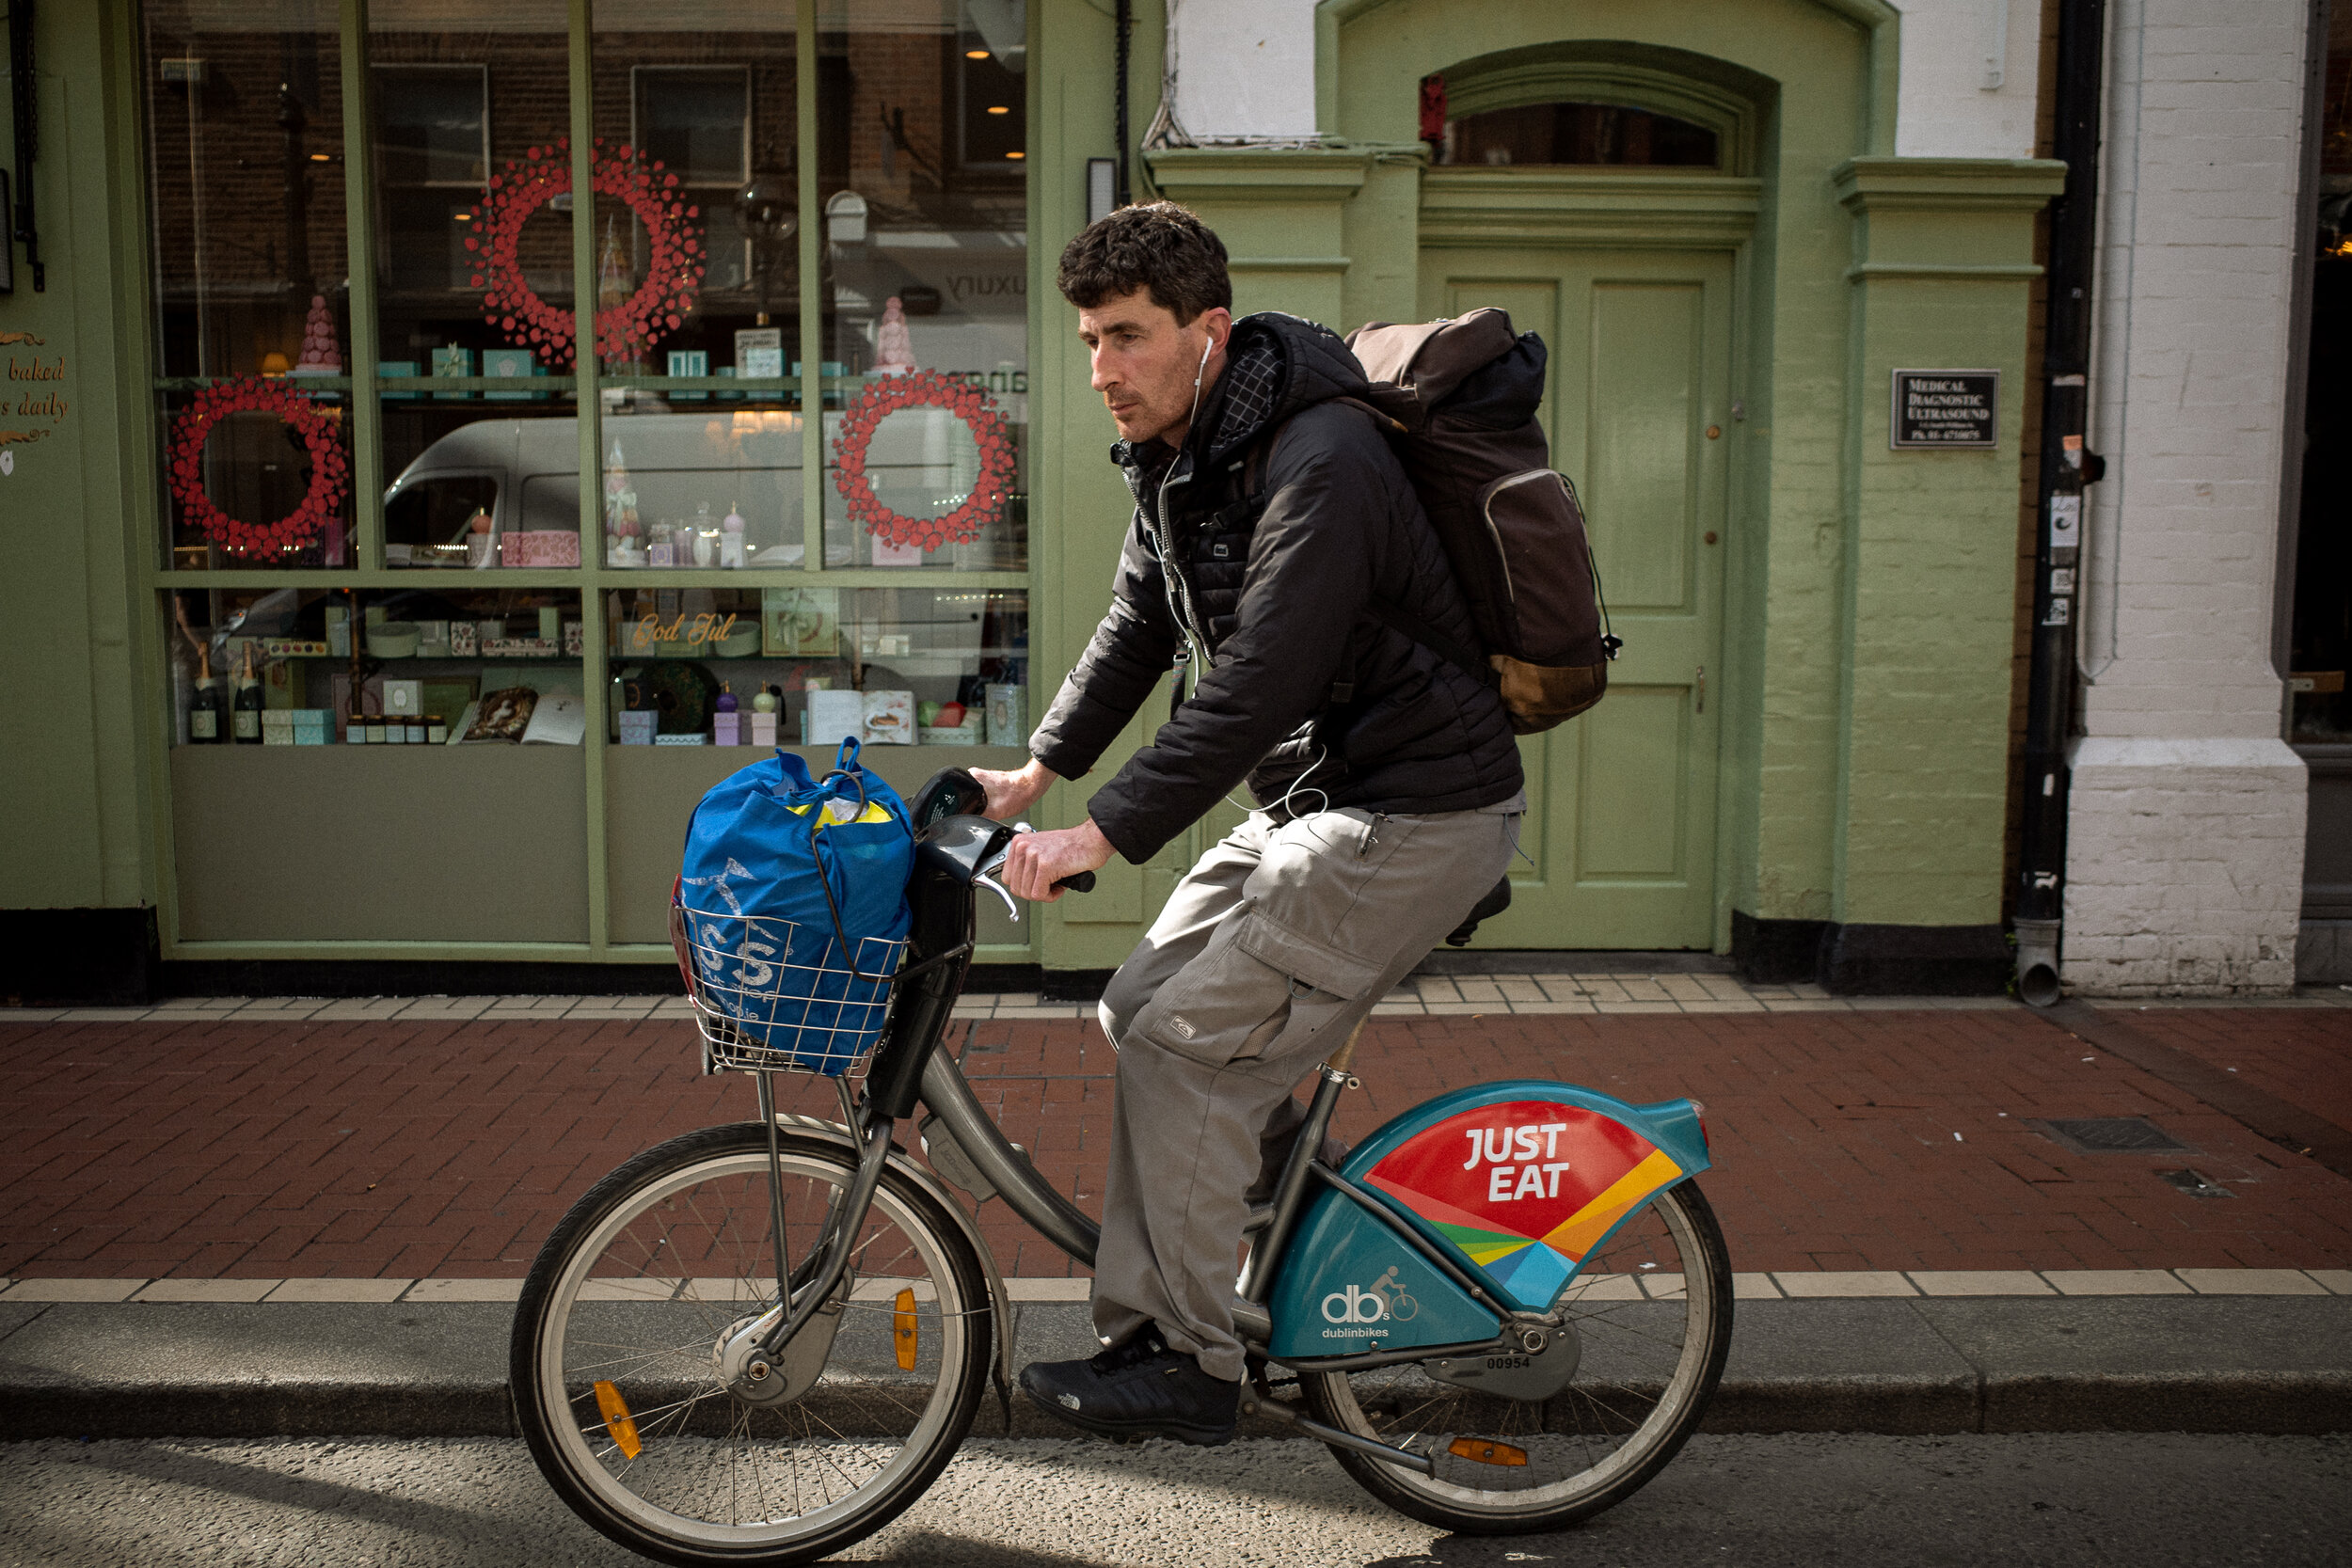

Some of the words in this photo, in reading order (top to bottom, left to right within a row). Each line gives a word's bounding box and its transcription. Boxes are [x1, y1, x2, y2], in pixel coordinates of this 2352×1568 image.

[9, 355, 66, 381] baked
[1909, 378, 1967, 392] MEDICAL
[18, 391, 69, 423] daily
[1908, 393, 1984, 406] DIAGNOSTIC
[1907, 406, 1991, 420] ULTRASOUND
[633, 612, 686, 649] God
[1463, 1122, 1567, 1171] JUST
[1488, 1162, 1570, 1202] EAT
[1322, 1327, 1389, 1338] dublinbikes
[1486, 1356, 1530, 1370] 00954
